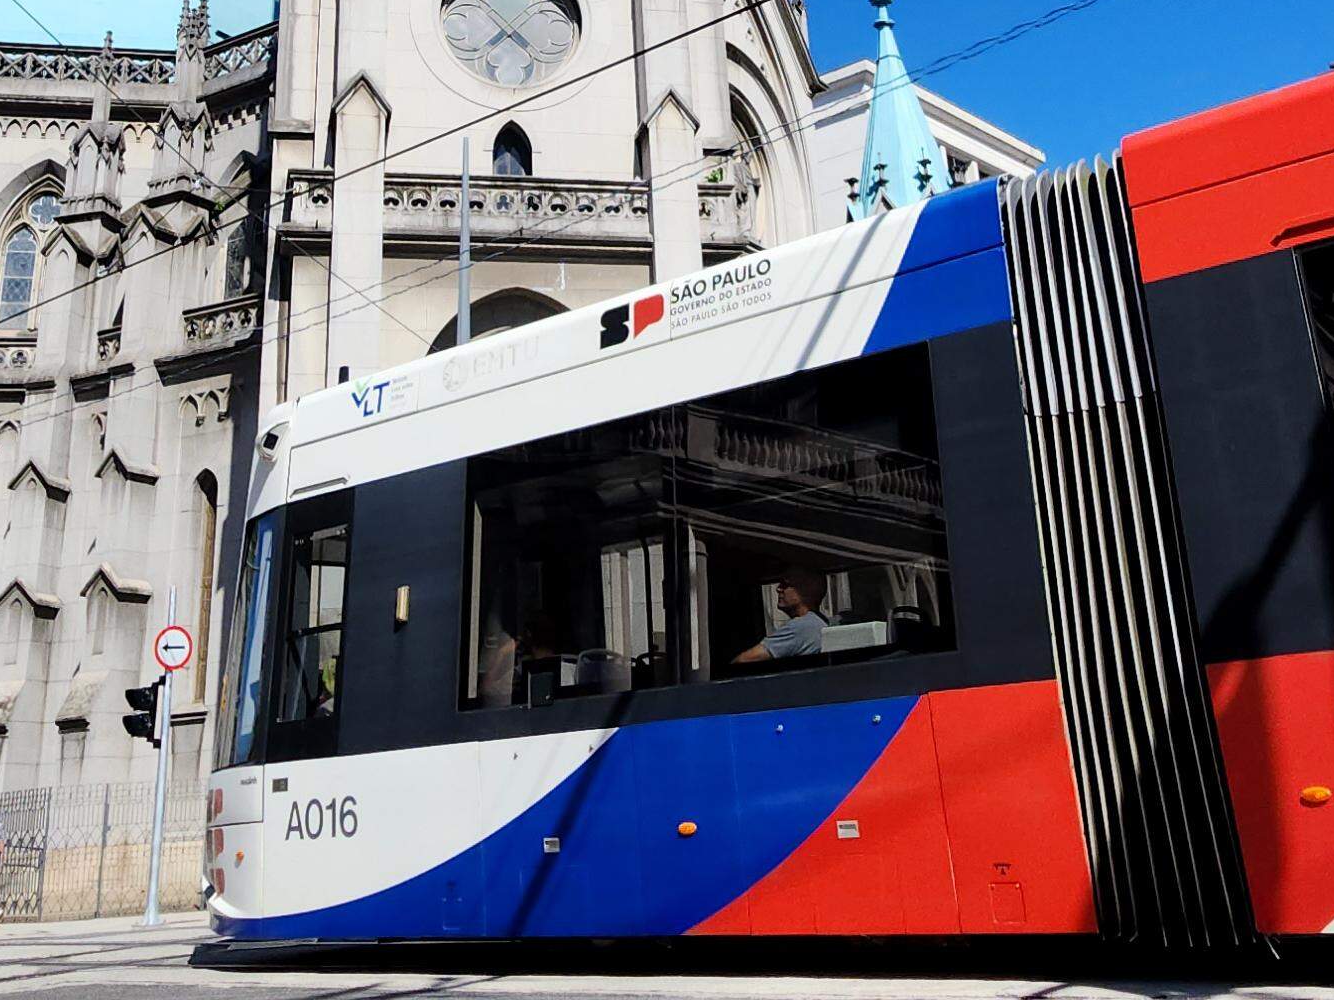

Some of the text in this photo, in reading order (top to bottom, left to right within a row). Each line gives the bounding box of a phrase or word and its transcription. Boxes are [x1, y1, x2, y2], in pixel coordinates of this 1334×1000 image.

[670, 277, 772, 316] GOVERNO DO ESTADO
[671, 259, 771, 304] SÃO PAULO
[691, 308, 718, 324] PAULO
[742, 292, 772, 307] TODOS
[351, 380, 390, 418] VLT
[285, 795, 358, 841] A016
